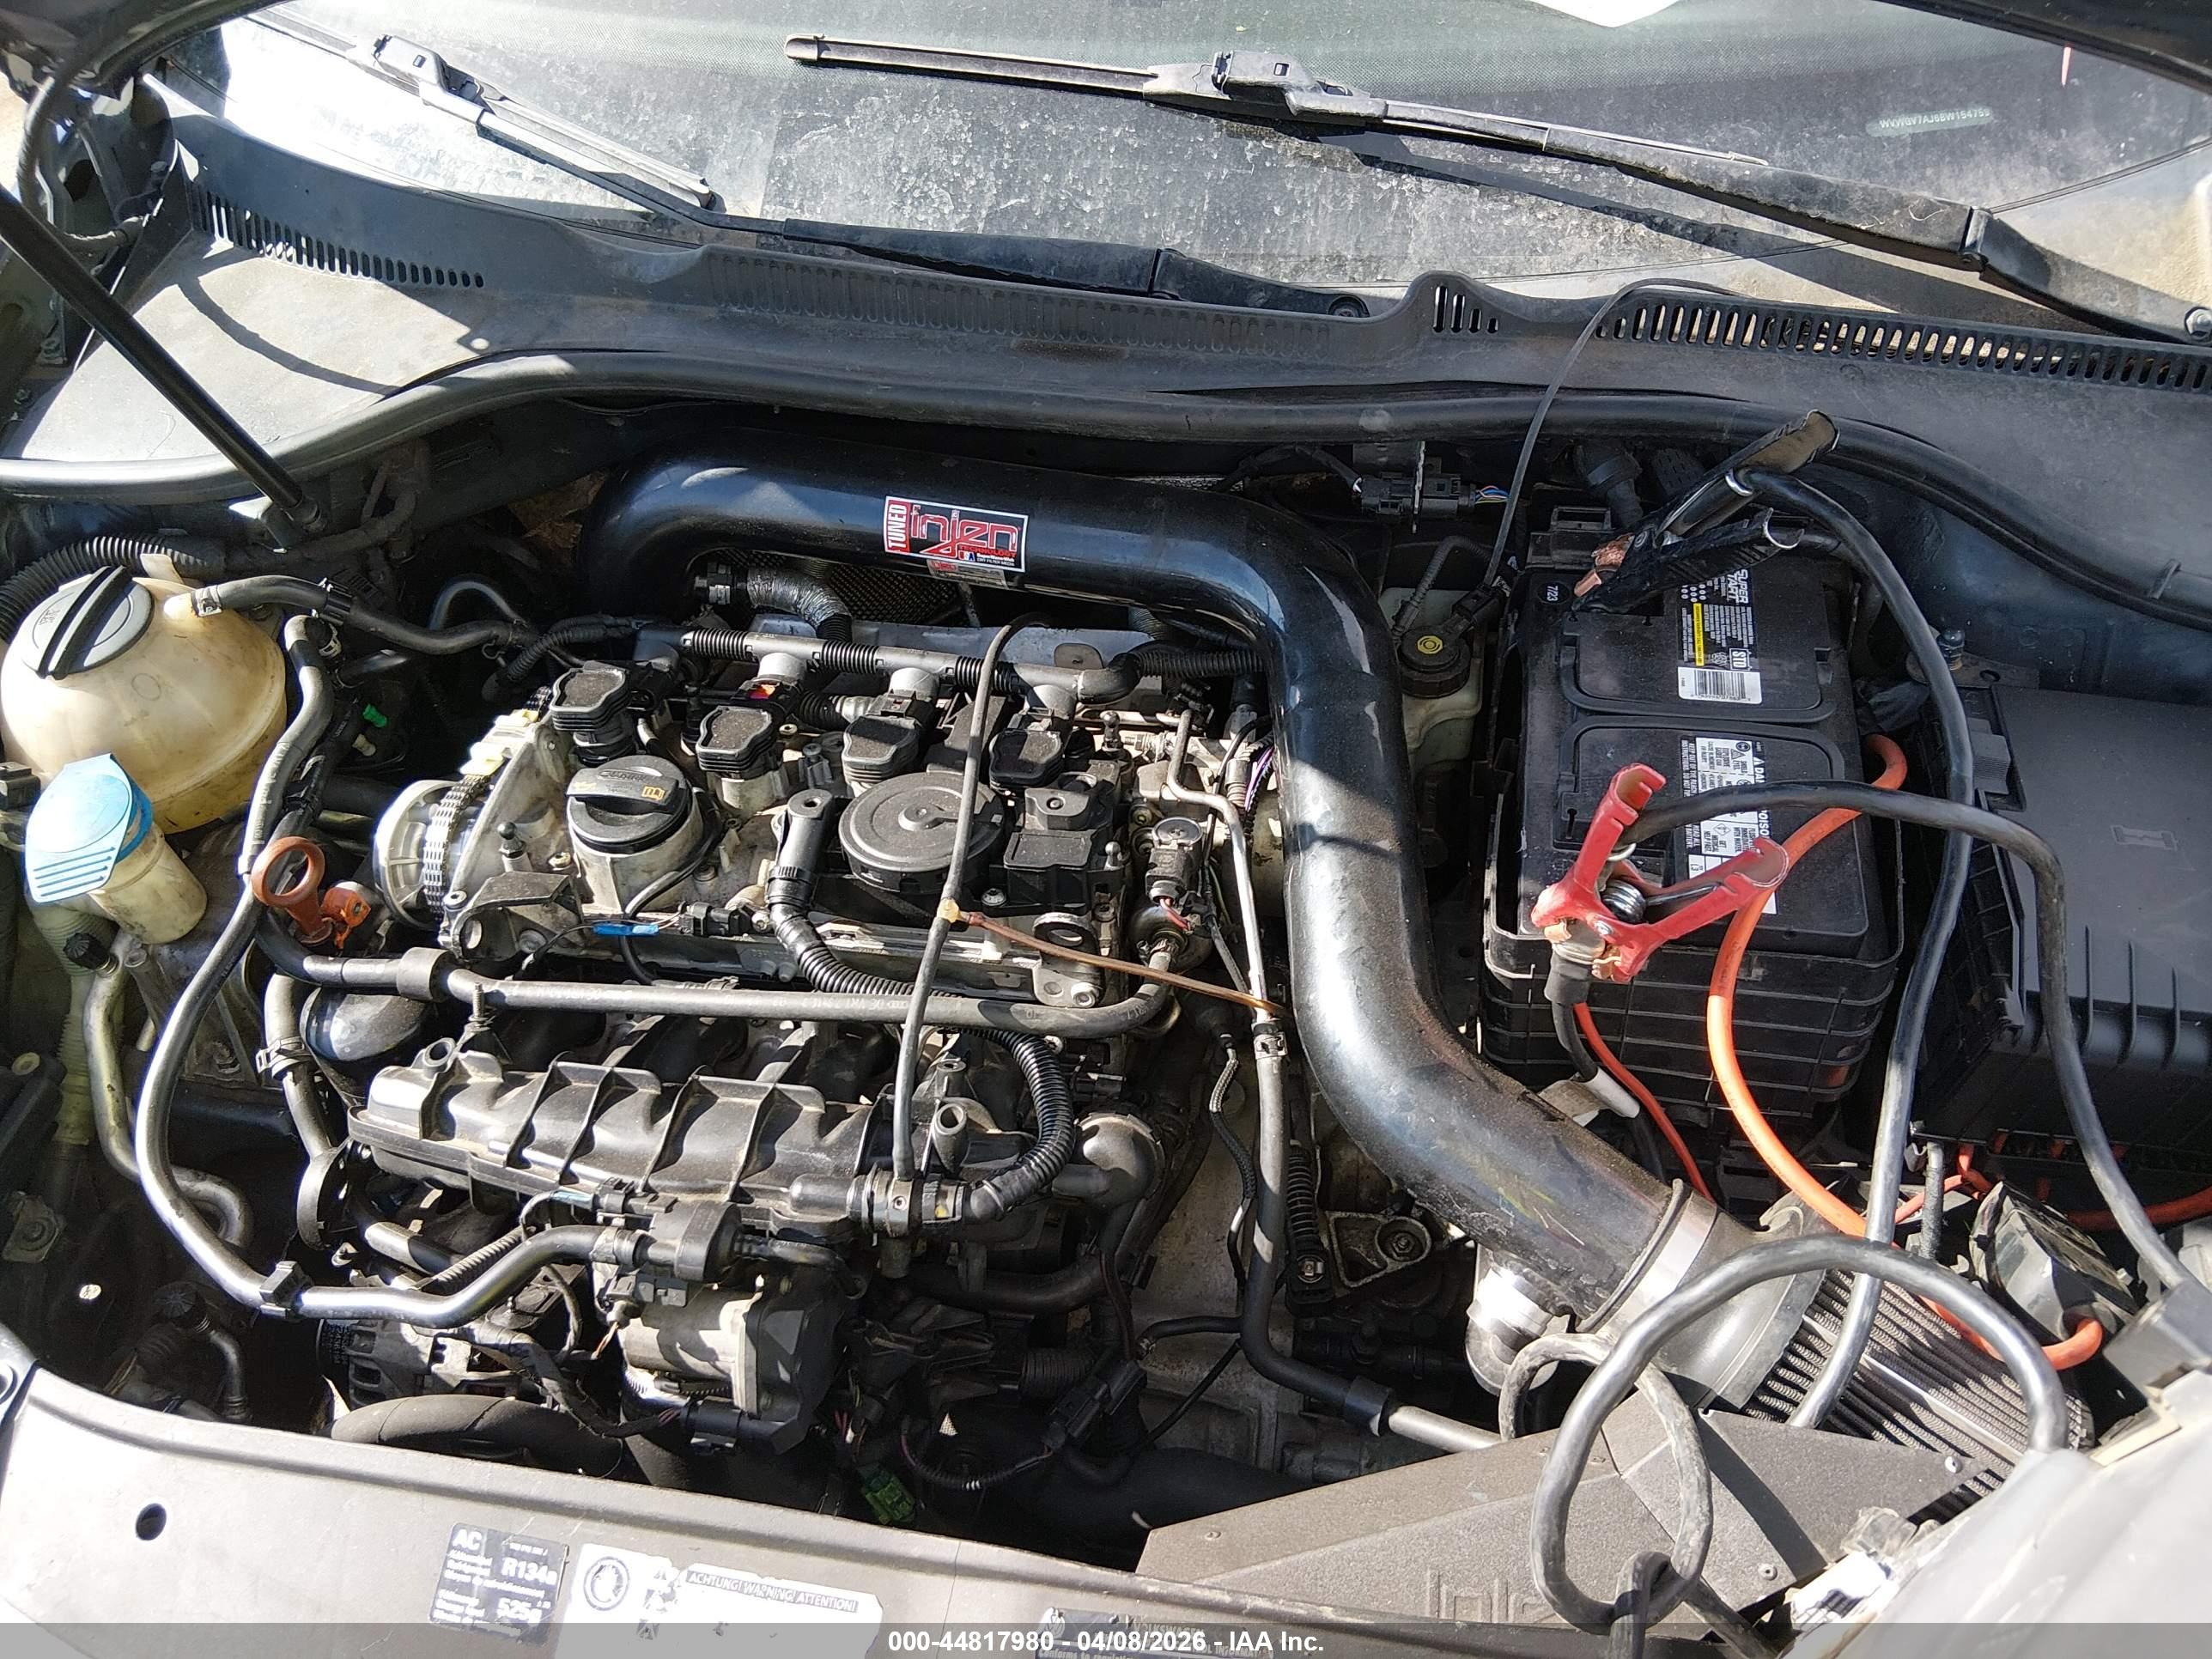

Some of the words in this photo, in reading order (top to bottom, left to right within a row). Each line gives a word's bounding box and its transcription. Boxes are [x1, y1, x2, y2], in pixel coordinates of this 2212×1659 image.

[888, 503, 908, 549] TUNED
[911, 504, 1018, 558] injen
[958, 544, 1018, 558] TECHNOLOGY
[1547, 586, 1559, 601] 7/23
[1728, 571, 1739, 603] TART
[1737, 569, 1748, 604] SUPER
[452, 1528, 482, 1551] AC
[501, 1556, 558, 1585] R134a
[689, 1571, 742, 1591] ACHTUNG!
[744, 1581, 796, 1602] WARNING!
[797, 1590, 856, 1613] ATTENTION!
